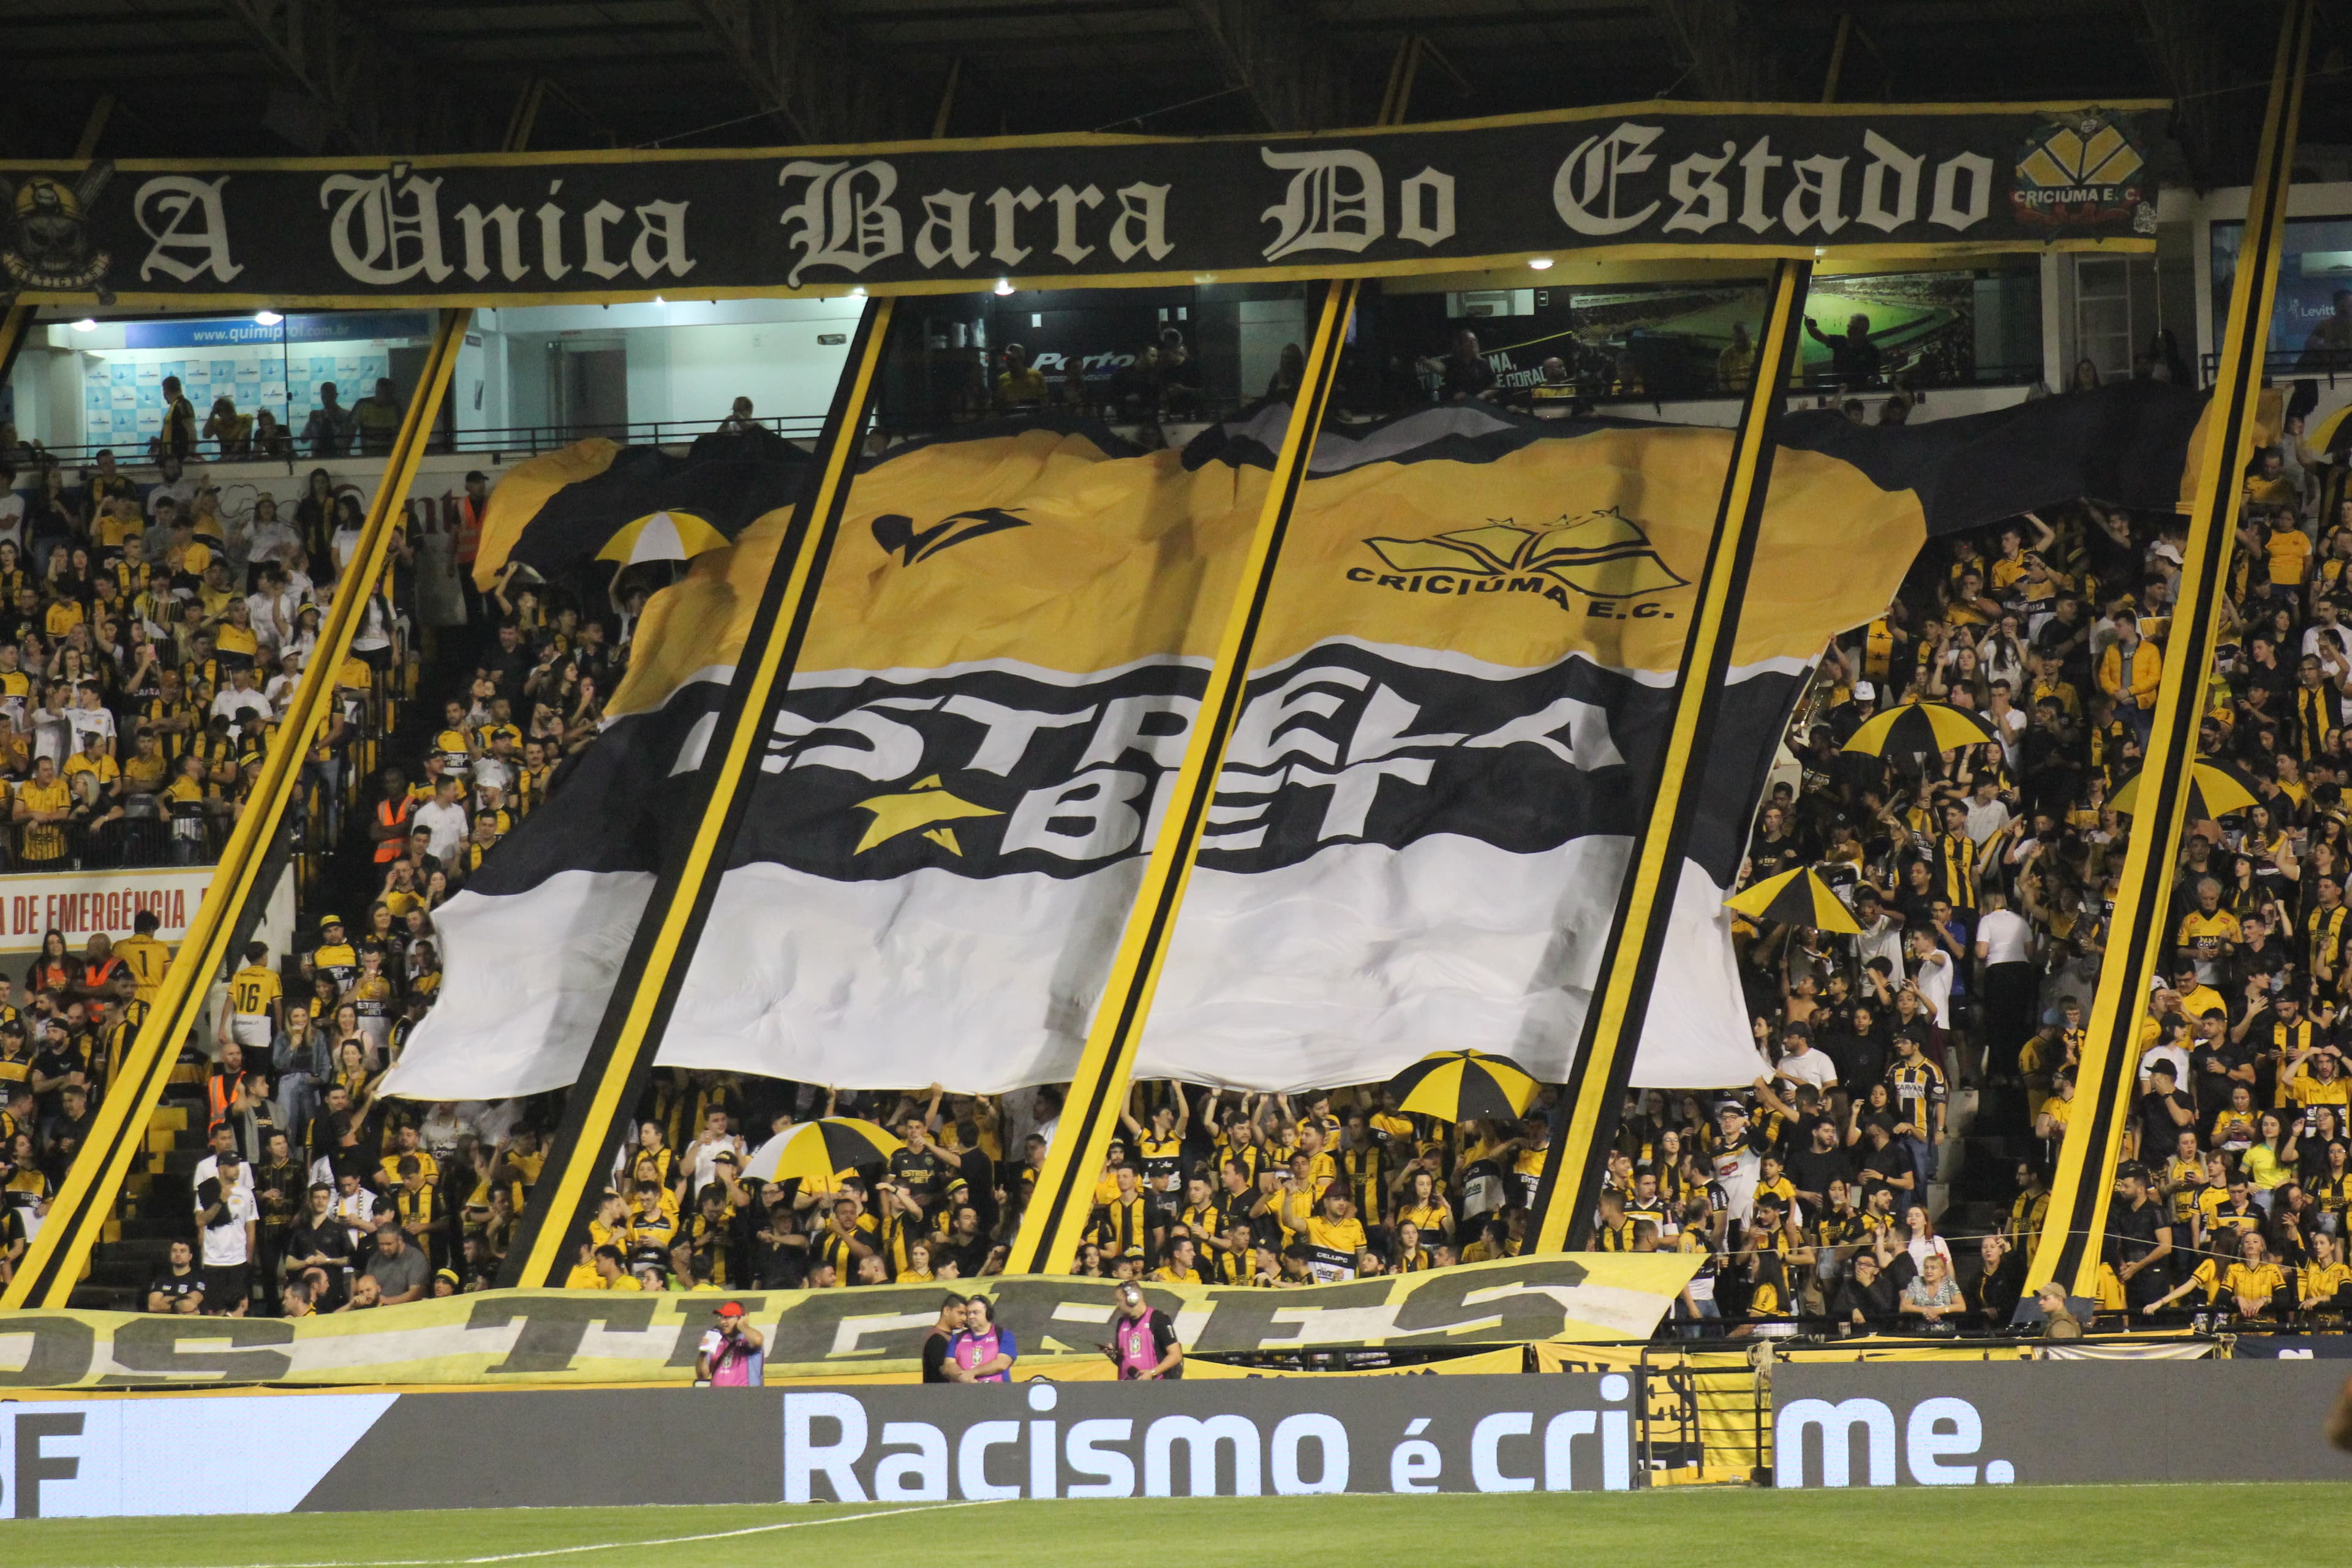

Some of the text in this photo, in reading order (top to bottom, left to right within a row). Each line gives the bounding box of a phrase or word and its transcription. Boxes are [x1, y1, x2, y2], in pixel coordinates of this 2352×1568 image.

[134, 122, 1994, 289] A Única Barra Do Estado
[2014, 187, 2098, 203] CRICIÚMA
[2301, 304, 2335, 317] Levitt
[1346, 567, 1675, 620] CRICIÚMA E.C.
[668, 666, 1626, 782] ESTRELA
[1000, 757, 1436, 857] BET
[13, 895, 39, 935] DE
[47, 888, 186, 935] EMERGÊNCIA
[138, 950, 148, 978] 1
[239, 983, 260, 1012] 16
[901, 1169, 935, 1178] ESTRELA
[466, 1260, 1590, 1374] TIGRES
[0, 1411, 87, 1520] F
[783, 1384, 1349, 1503] Racismo
[1390, 1418, 1441, 1493] é
